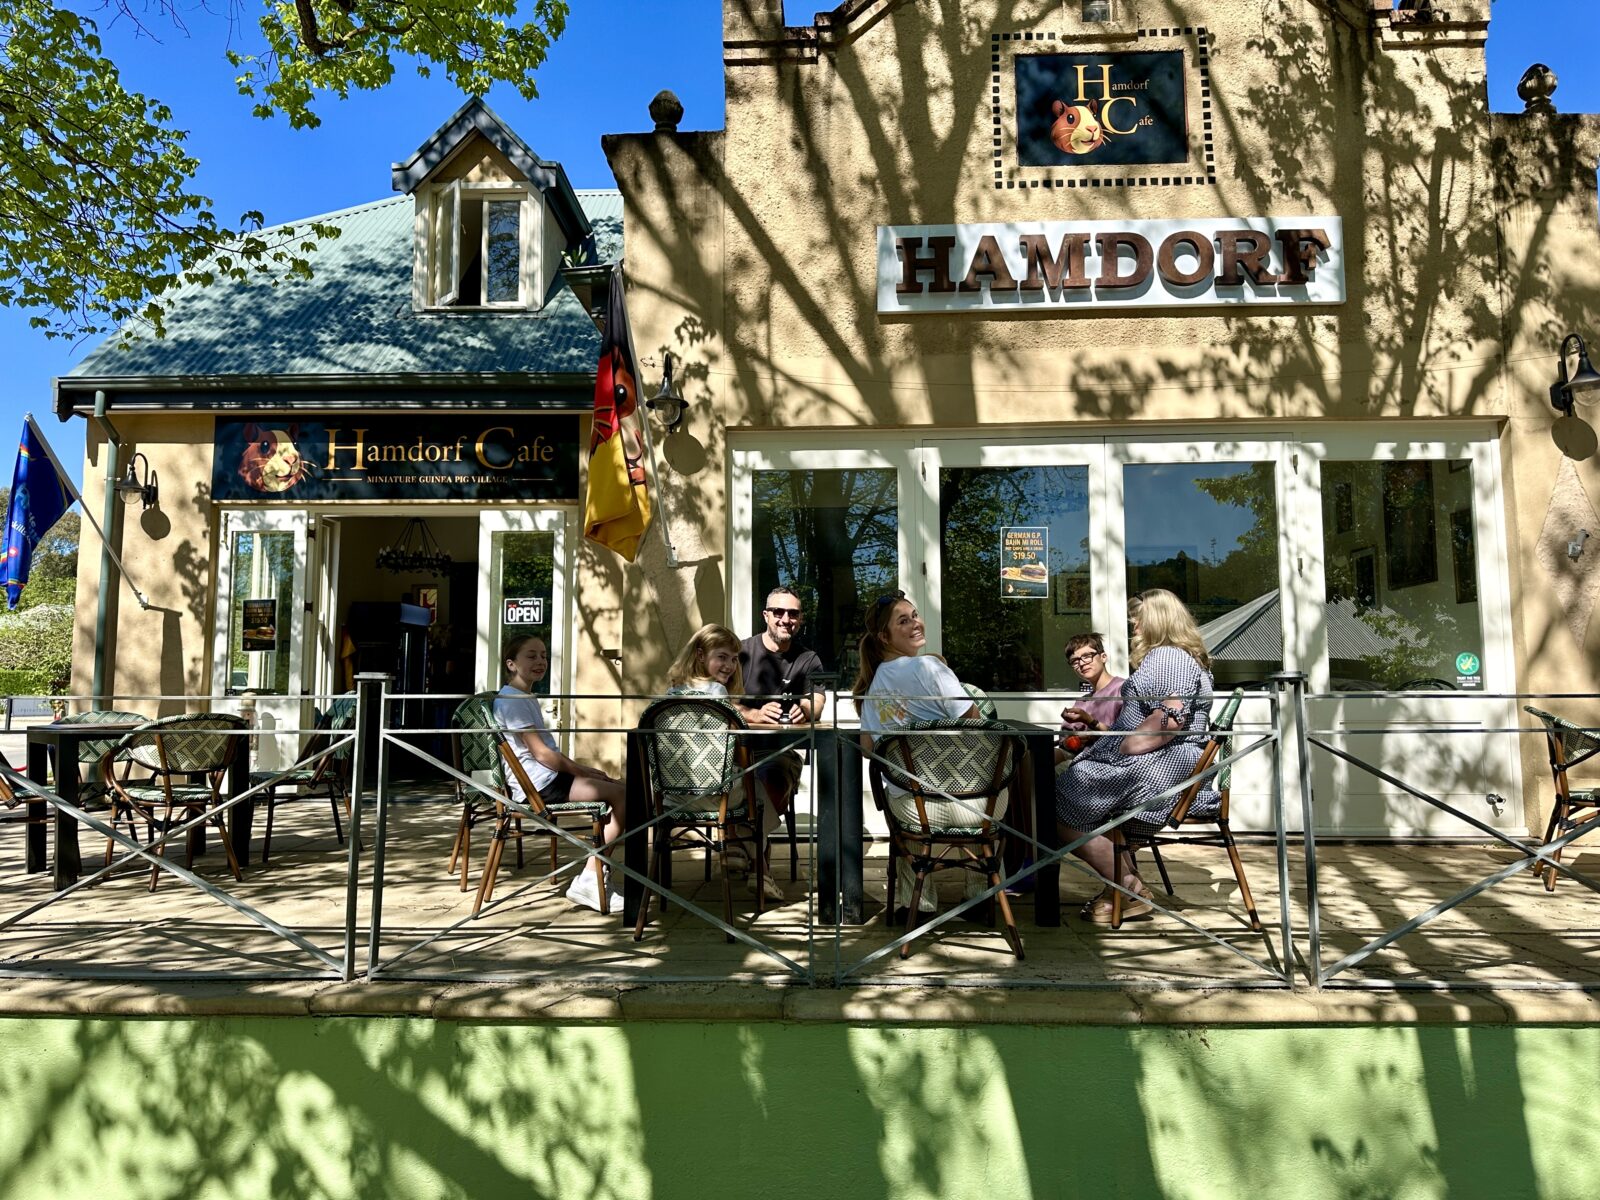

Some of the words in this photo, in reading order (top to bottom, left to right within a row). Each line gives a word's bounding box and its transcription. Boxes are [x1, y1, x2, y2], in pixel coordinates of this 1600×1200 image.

[1072, 64, 1150, 102] Hamdorf
[1101, 96, 1153, 135] Cafe
[895, 228, 1332, 294] HAMDORF
[322, 428, 468, 471] Hamdorf
[475, 426, 554, 470] Cafe
[367, 475, 417, 484] MINIATURE
[419, 475, 452, 484] GUINEA
[454, 475, 470, 484] PIG
[471, 475, 508, 484] VILLAGE
[1013, 552, 1036, 560] $19.50
[507, 606, 540, 622] OPEN
